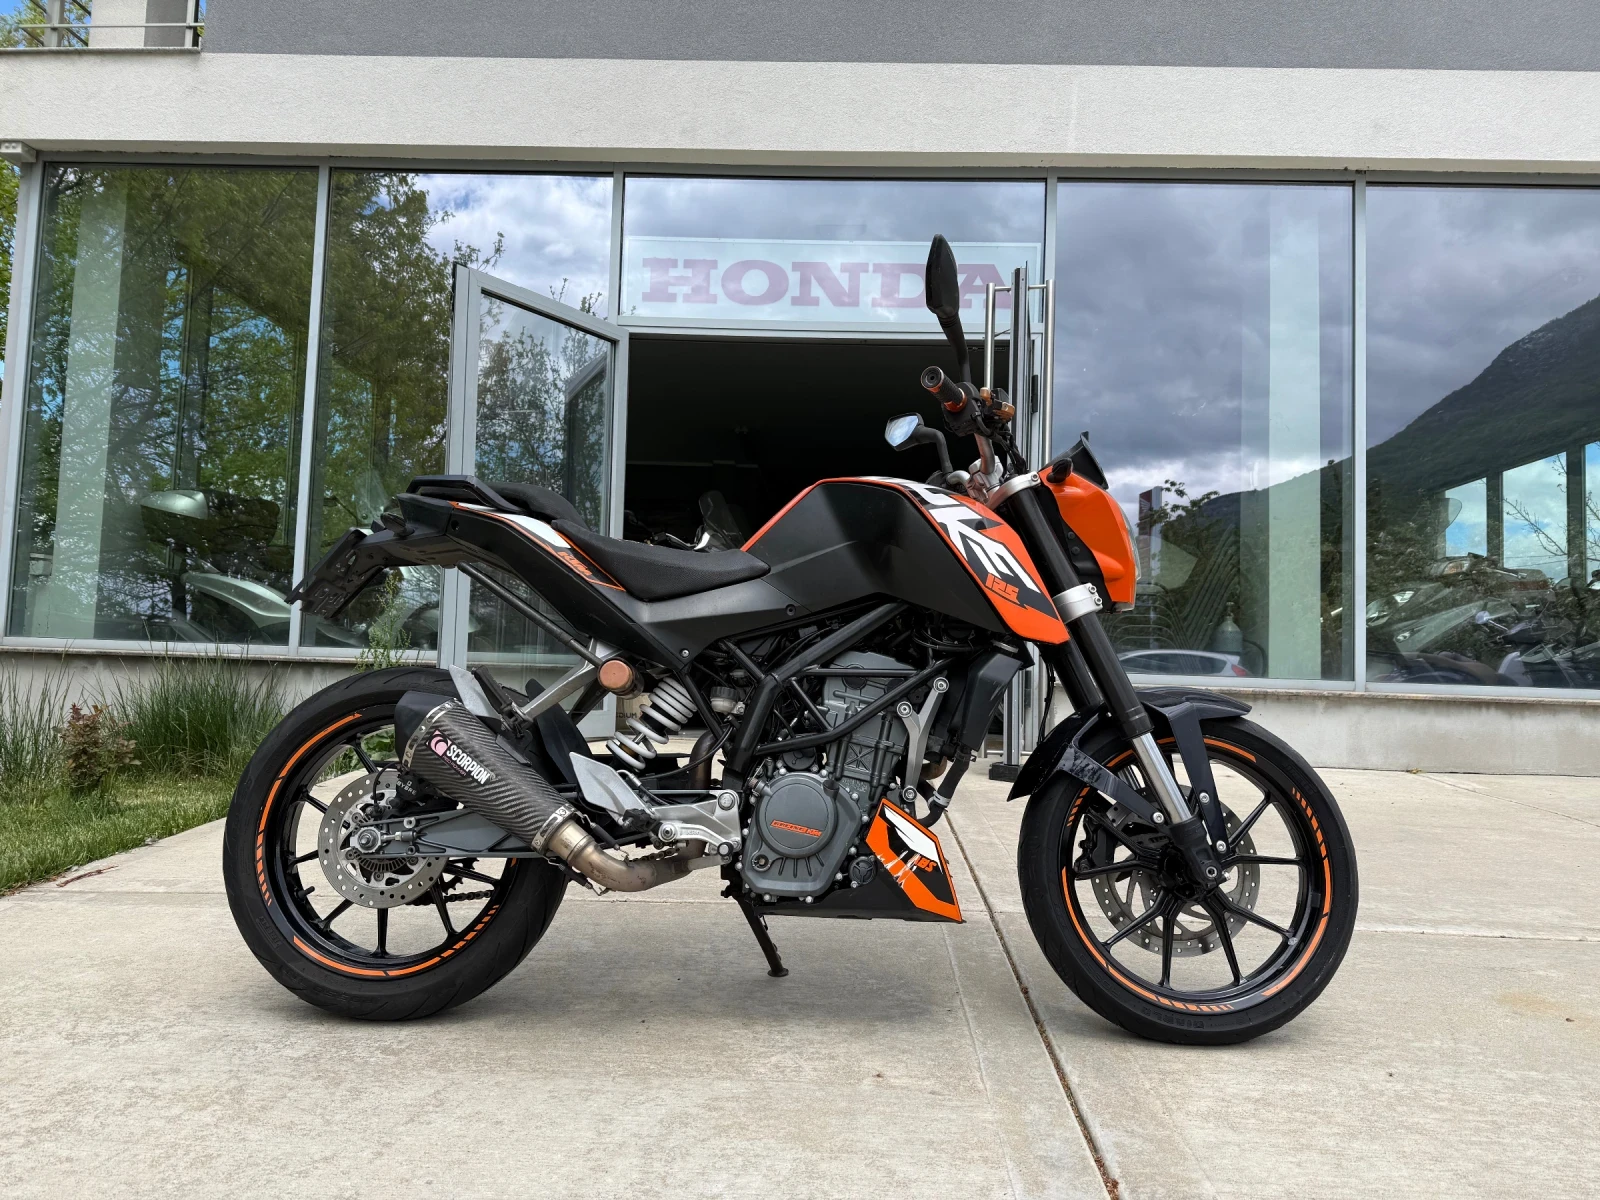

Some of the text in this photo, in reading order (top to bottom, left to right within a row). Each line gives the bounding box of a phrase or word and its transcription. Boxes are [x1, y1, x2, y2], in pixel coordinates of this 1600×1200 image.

[642, 257, 1011, 309] HONDA
[557, 551, 593, 576] KTM
[986, 573, 1020, 604] 125
[446, 744, 491, 785] SCORPION
[396, 780, 417, 796] BYBRE
